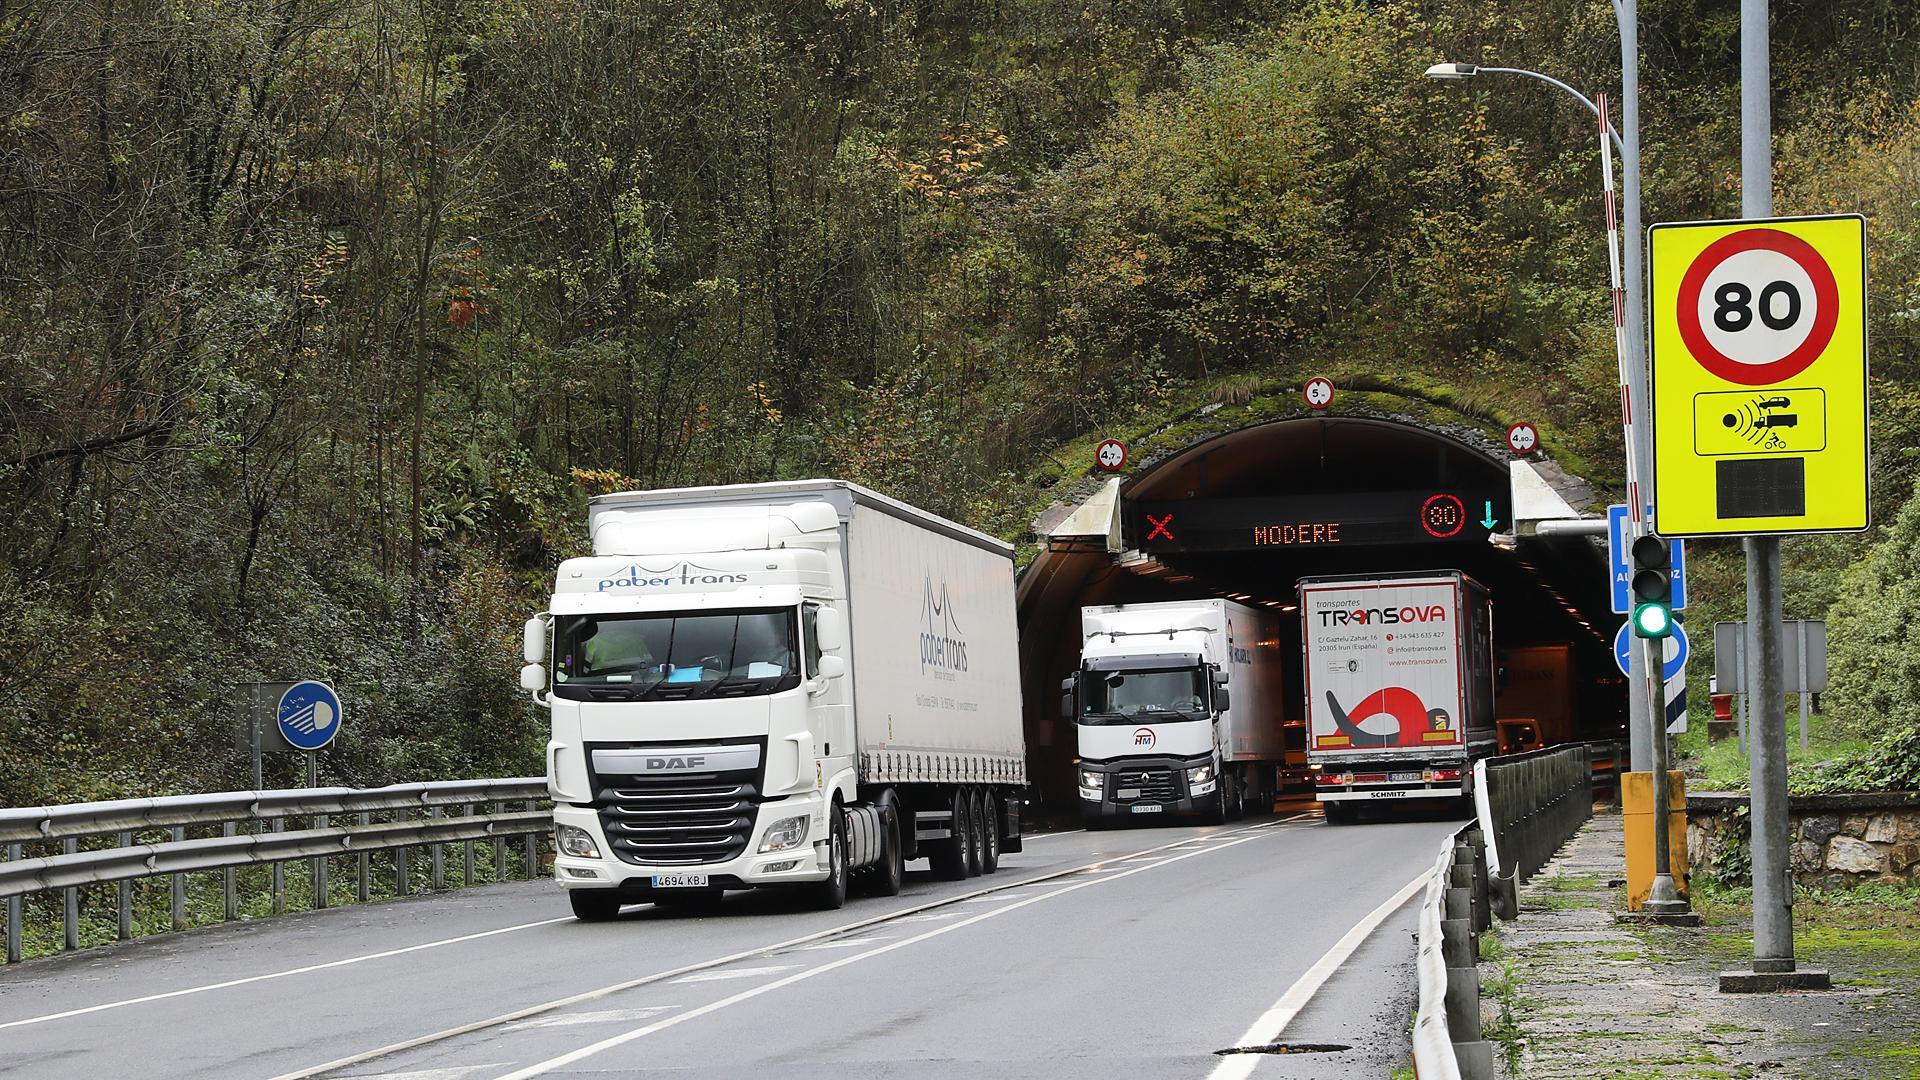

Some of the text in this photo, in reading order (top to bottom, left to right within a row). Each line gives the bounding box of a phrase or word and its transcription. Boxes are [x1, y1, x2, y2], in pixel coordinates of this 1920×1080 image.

[1713, 280, 1802, 332] 80
[1312, 388, 1319, 398] 5
[1101, 451, 1115, 460] 4,7
[1430, 506, 1456, 525] 80
[1254, 523, 1340, 545] MODERE
[1316, 599, 1361, 609] transportes
[1407, 631, 1419, 640] 943
[1420, 631, 1432, 639] 635
[1388, 657, 1448, 667] www.transova.es
[646, 756, 705, 770] DAF
[658, 875, 707, 886] 4694 KBJ
